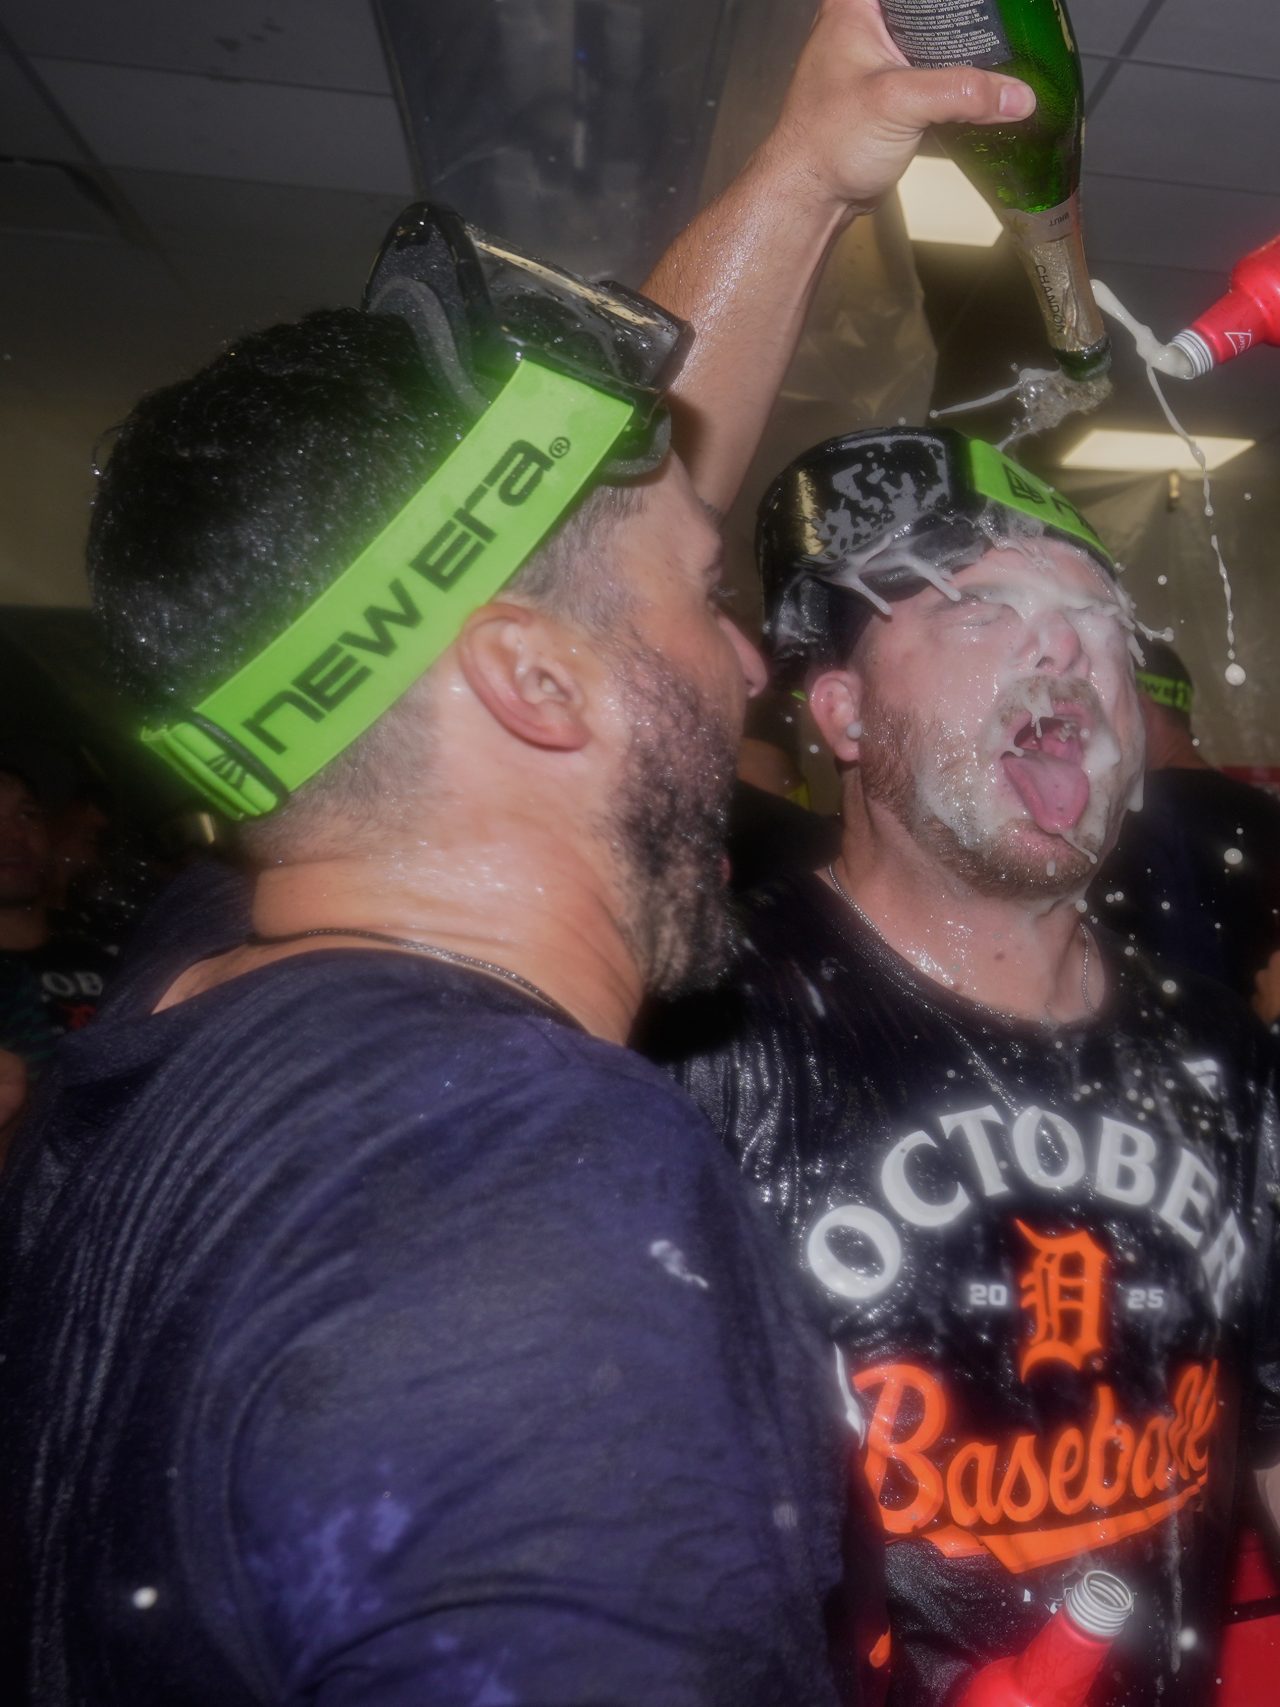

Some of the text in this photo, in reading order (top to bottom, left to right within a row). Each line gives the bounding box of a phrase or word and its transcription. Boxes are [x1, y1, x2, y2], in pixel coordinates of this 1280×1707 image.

[1034, 265, 1066, 334] CHANDON
[806, 1104, 1246, 1319] OCTOBER
[968, 1283, 1008, 1307] 20
[1126, 1288, 1164, 1310] 25
[853, 1358, 1220, 1534] Baseball
